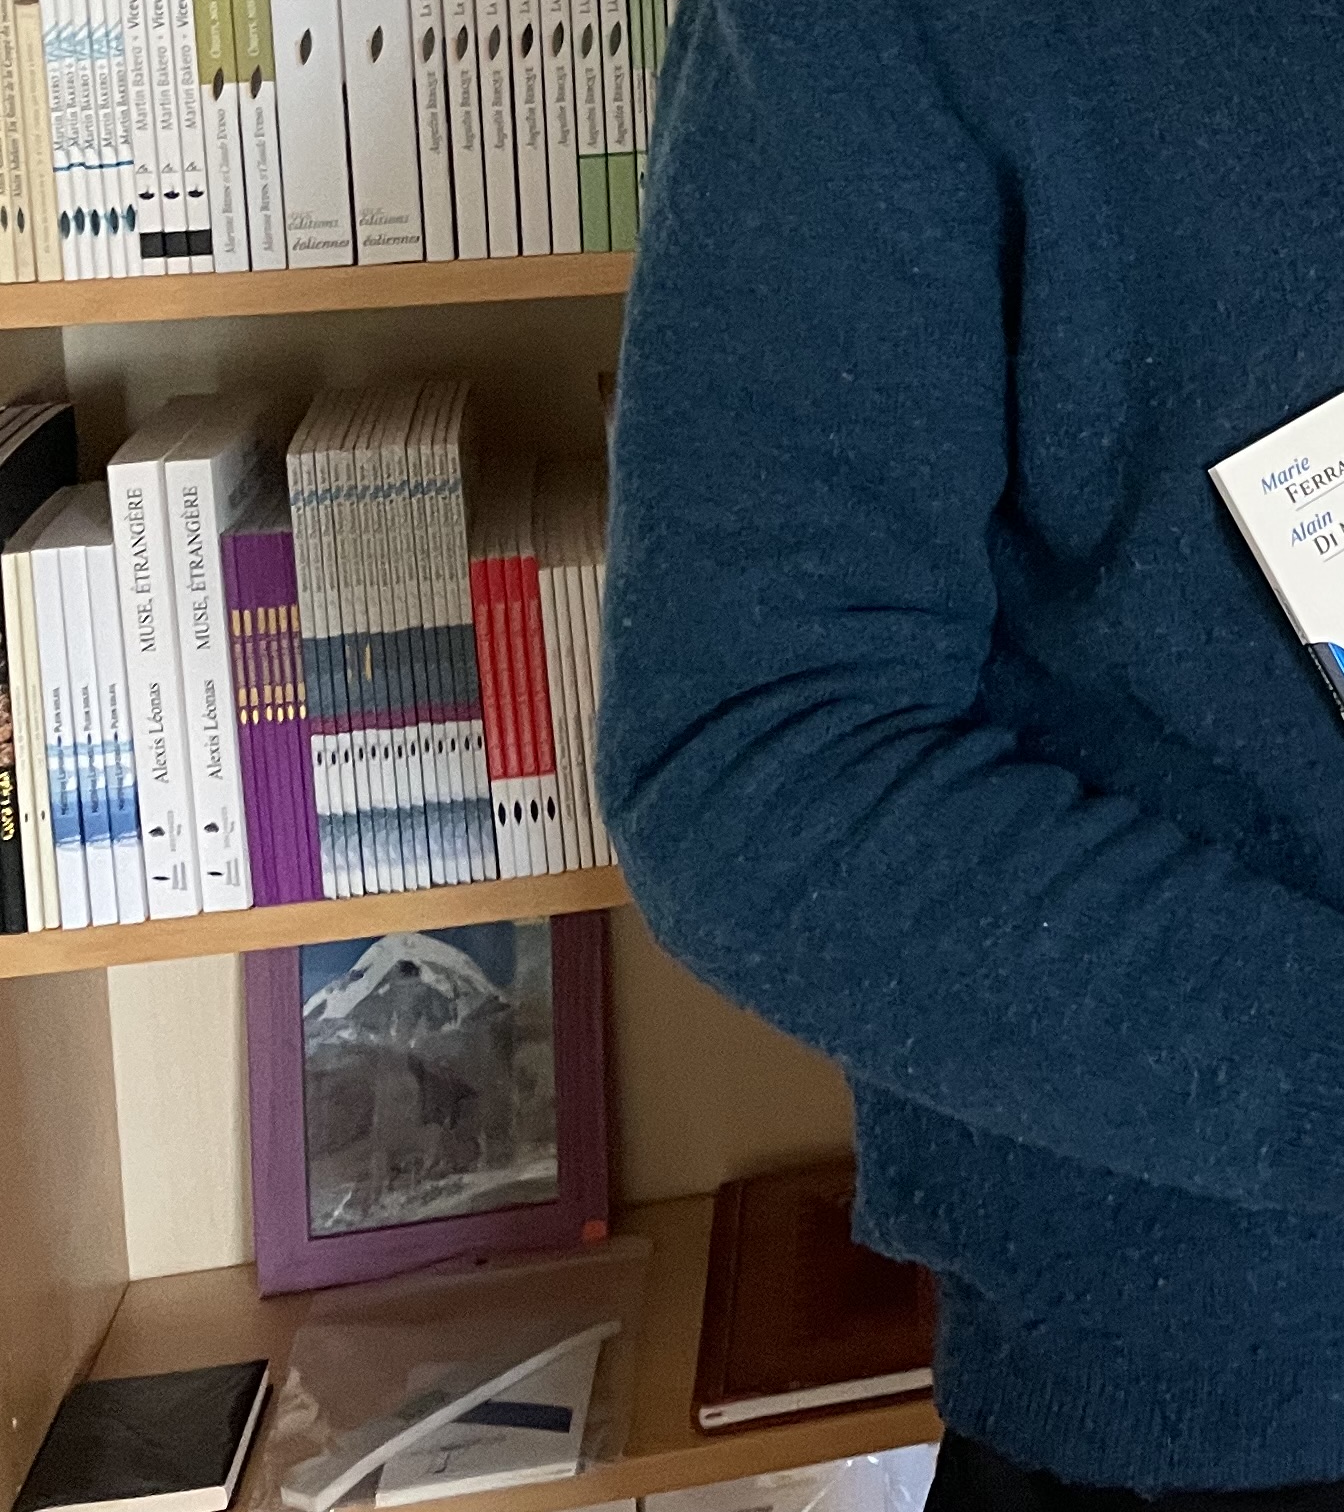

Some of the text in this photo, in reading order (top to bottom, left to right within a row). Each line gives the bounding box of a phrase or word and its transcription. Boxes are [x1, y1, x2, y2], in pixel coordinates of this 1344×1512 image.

[133, 90, 149, 131] Martin
[158, 90, 175, 131] Martin
[182, 89, 198, 130] Martin
[1261, 455, 1311, 496] Marie
[1290, 509, 1334, 547] Alain
[1312, 533, 1338, 556] DI
[123, 486, 158, 655] MUSE, ÉTRANGÈRE
[181, 484, 213, 652] MUSE, ÉTRANGÈRE
[146, 681, 172, 785] Alexis Léonas
[200, 678, 225, 782] Alexis Léonas
